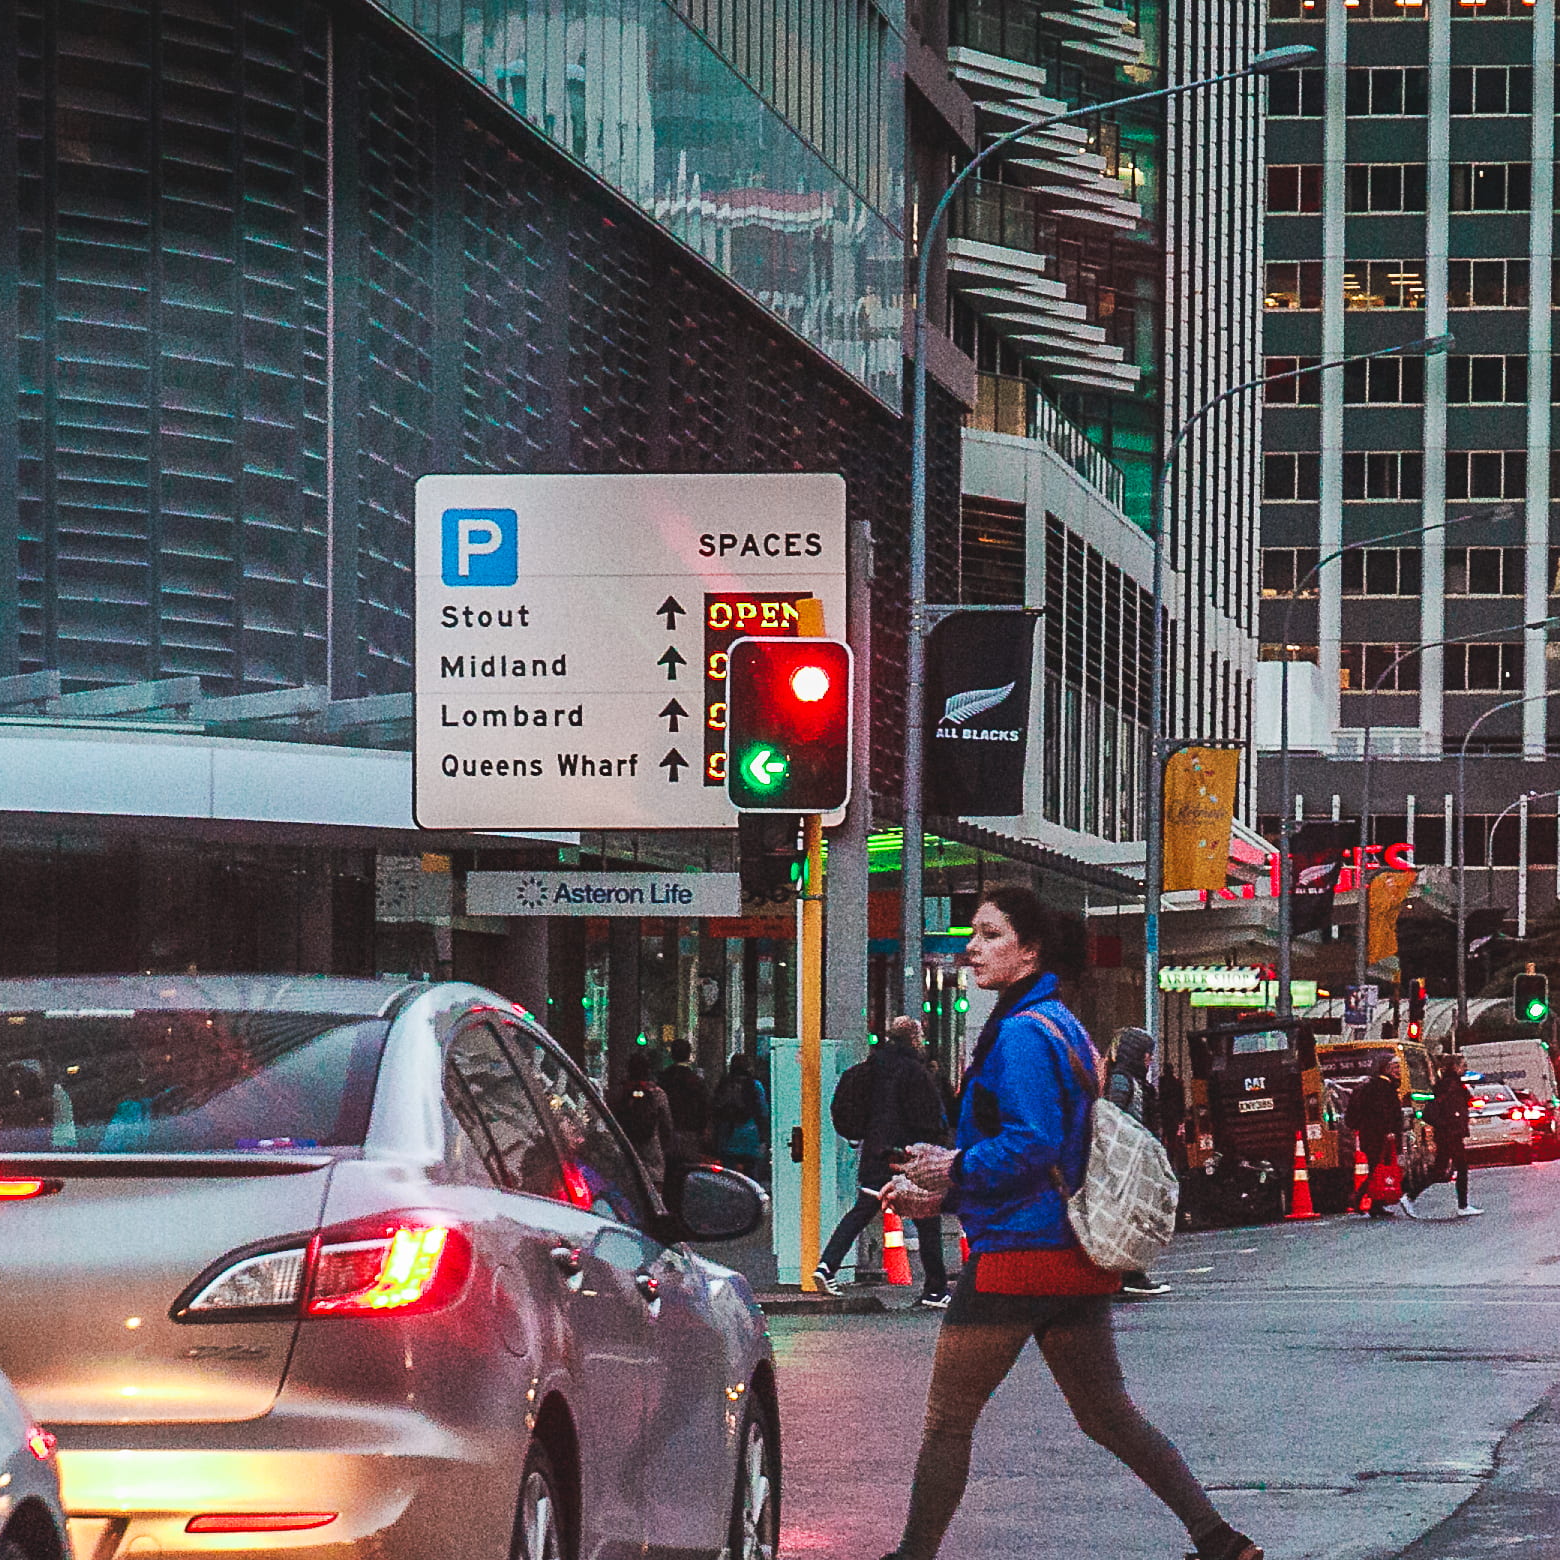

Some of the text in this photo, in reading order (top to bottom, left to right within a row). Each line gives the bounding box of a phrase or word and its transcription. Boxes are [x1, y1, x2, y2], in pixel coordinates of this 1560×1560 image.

[457, 519, 503, 577] P
[698, 532, 823, 557] SPACES
[441, 605, 530, 628] Stout
[708, 602, 799, 629] OPEN
[441, 653, 567, 678] Midland
[441, 704, 583, 727] Lombard
[935, 727, 1019, 741] ALL BLACKS
[441, 753, 639, 778] Queens Wharf
[553, 883, 693, 905] Asteron Life
[1214, 973, 1249, 985] SHOP
[1244, 1076, 1266, 1091] CAT
